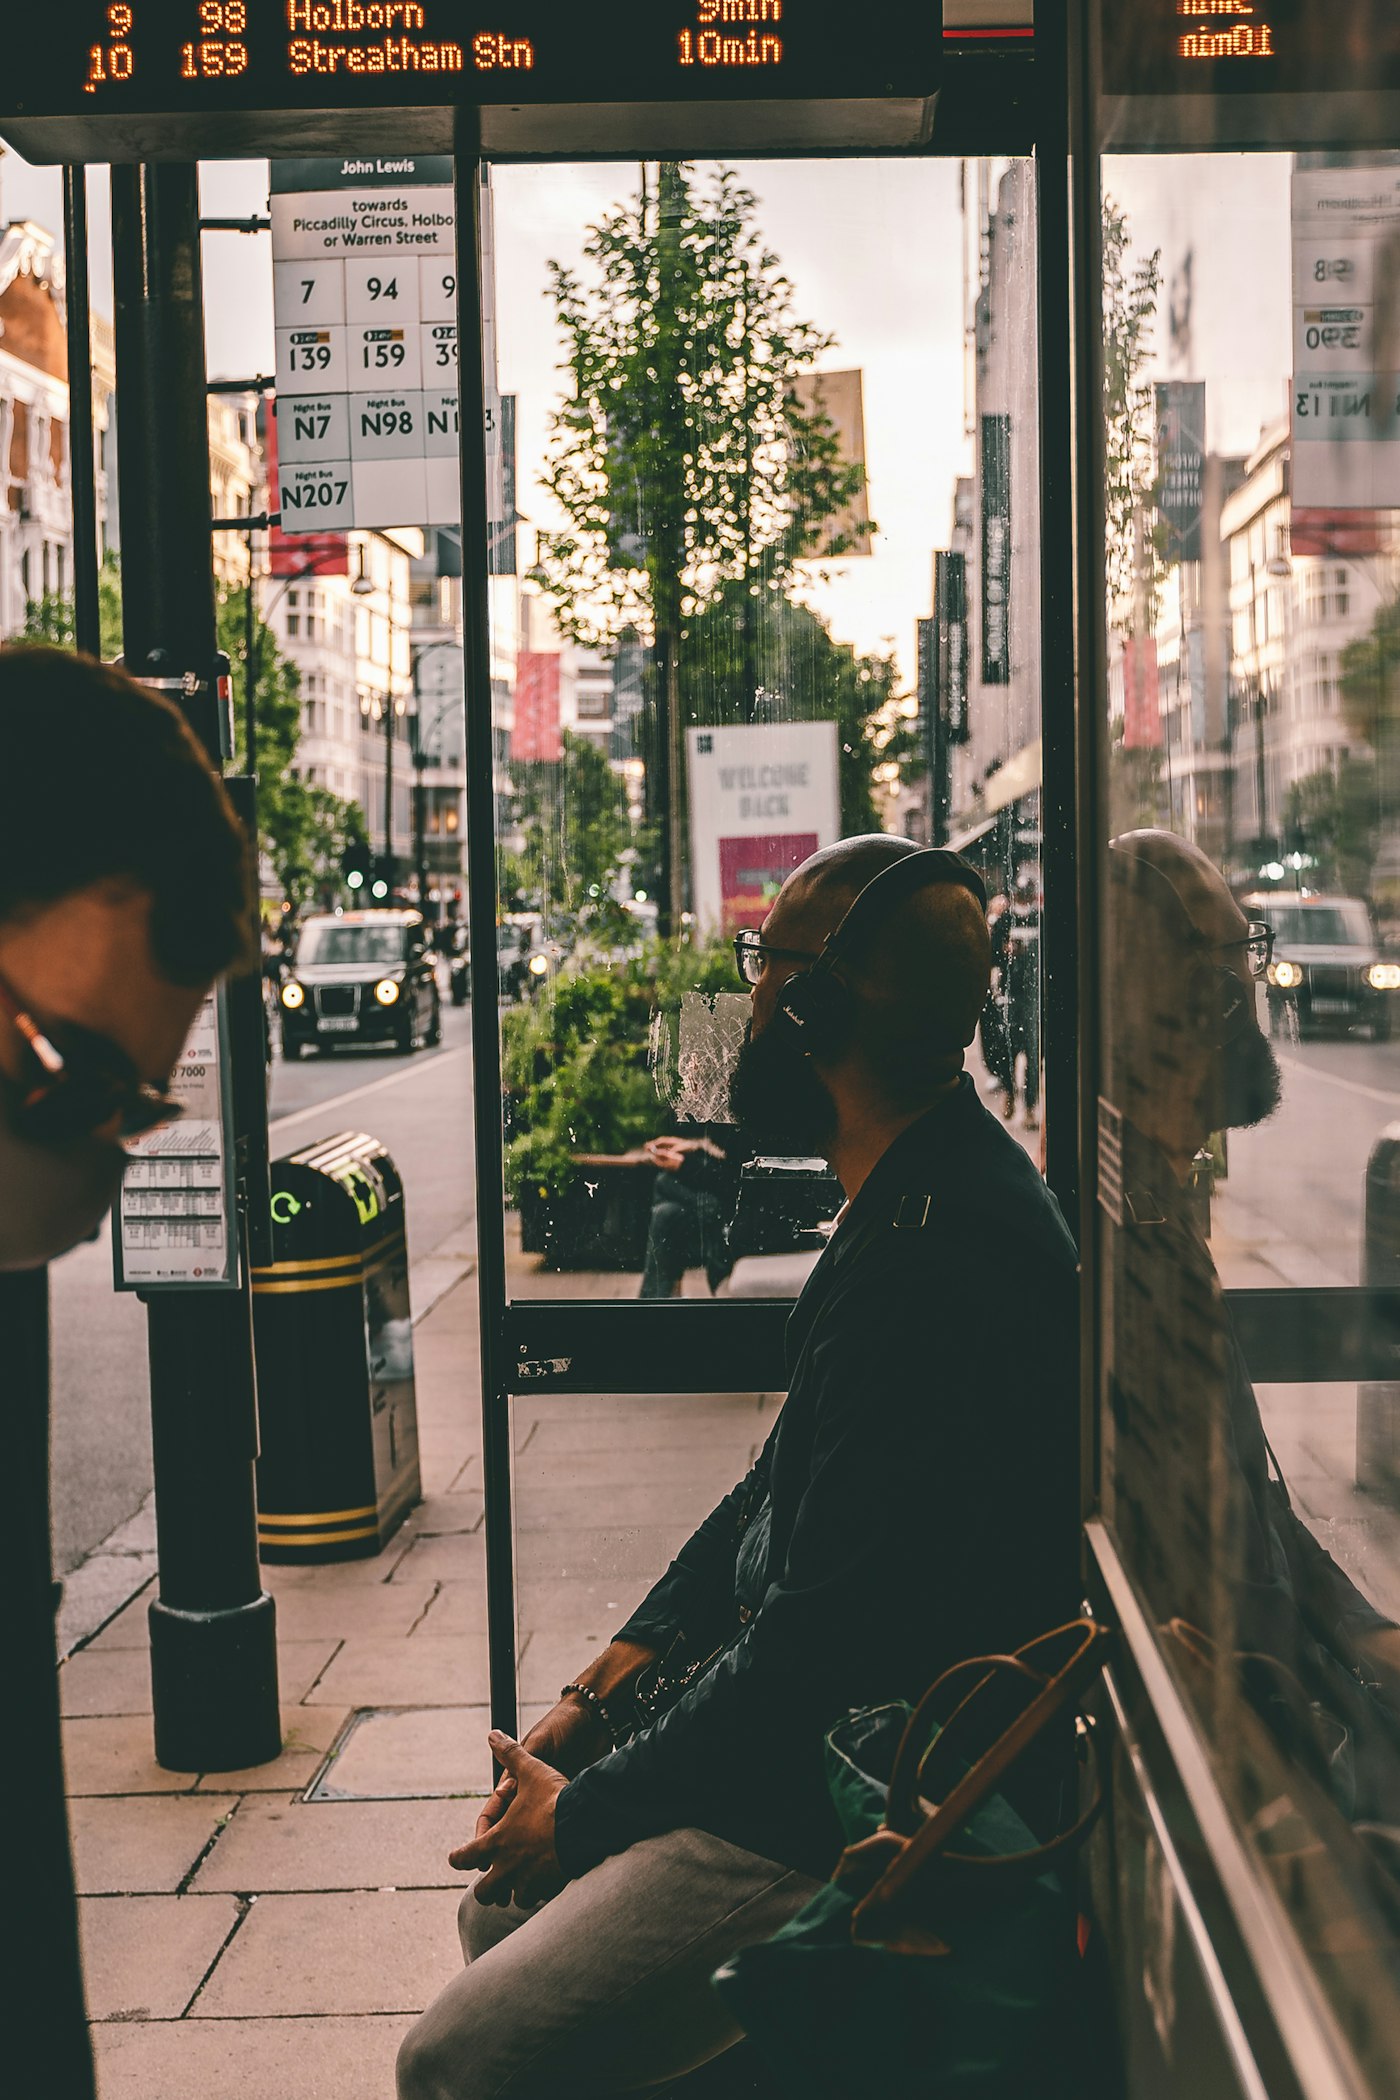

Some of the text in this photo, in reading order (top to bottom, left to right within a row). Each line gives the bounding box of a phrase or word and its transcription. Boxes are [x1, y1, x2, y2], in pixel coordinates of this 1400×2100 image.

[109, 4, 132, 37] 9
[200, 1, 247, 34] 98
[286, 0, 425, 31] Holborn
[90, 28, 782, 80] 10 159 Streatham Stn 10min
[340, 158, 415, 175] John Lewis
[352, 199, 408, 213] towards
[293, 217, 357, 232] Piccadilly
[412, 213, 454, 227] Holbo
[323, 231, 438, 248] or Warren Street
[301, 280, 315, 304] 7
[367, 277, 398, 301] 94
[442, 275, 456, 299] 9
[290, 346, 332, 372] 139
[363, 344, 405, 369] 159
[293, 402, 331, 414] Night Bus
[367, 398, 405, 409] Night Bus
[295, 415, 331, 441] N7
[361, 411, 413, 437] N98
[295, 470, 333, 481] Night Bus
[281, 481, 348, 510] N207
[181, 1066, 206, 1077] 7000
